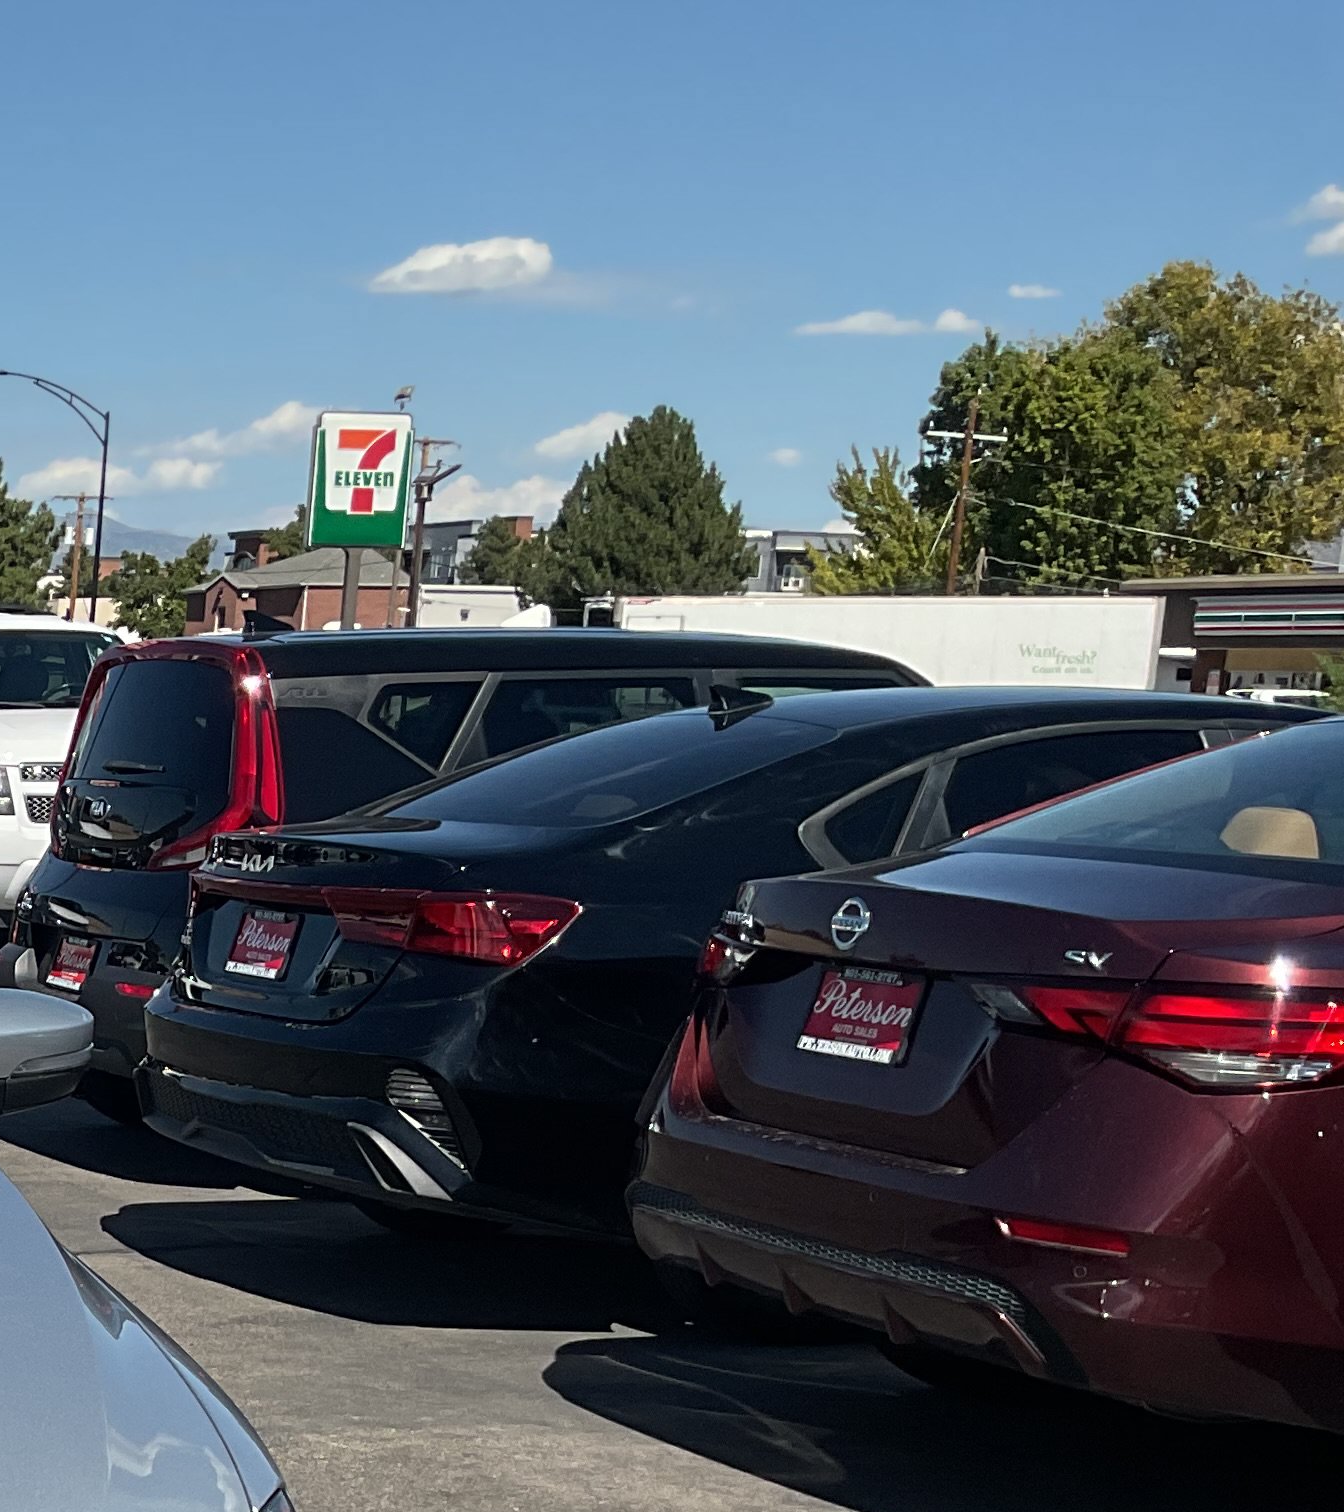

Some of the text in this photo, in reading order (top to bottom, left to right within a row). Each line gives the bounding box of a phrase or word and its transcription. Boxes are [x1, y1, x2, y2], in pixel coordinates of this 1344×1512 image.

[337, 428, 397, 512] 7
[1018, 643, 1097, 665] Want fresh?
[236, 919, 291, 953] Peterson
[813, 979, 913, 1028] Peterson
[831, 1023, 879, 1039] AUTO SALES
